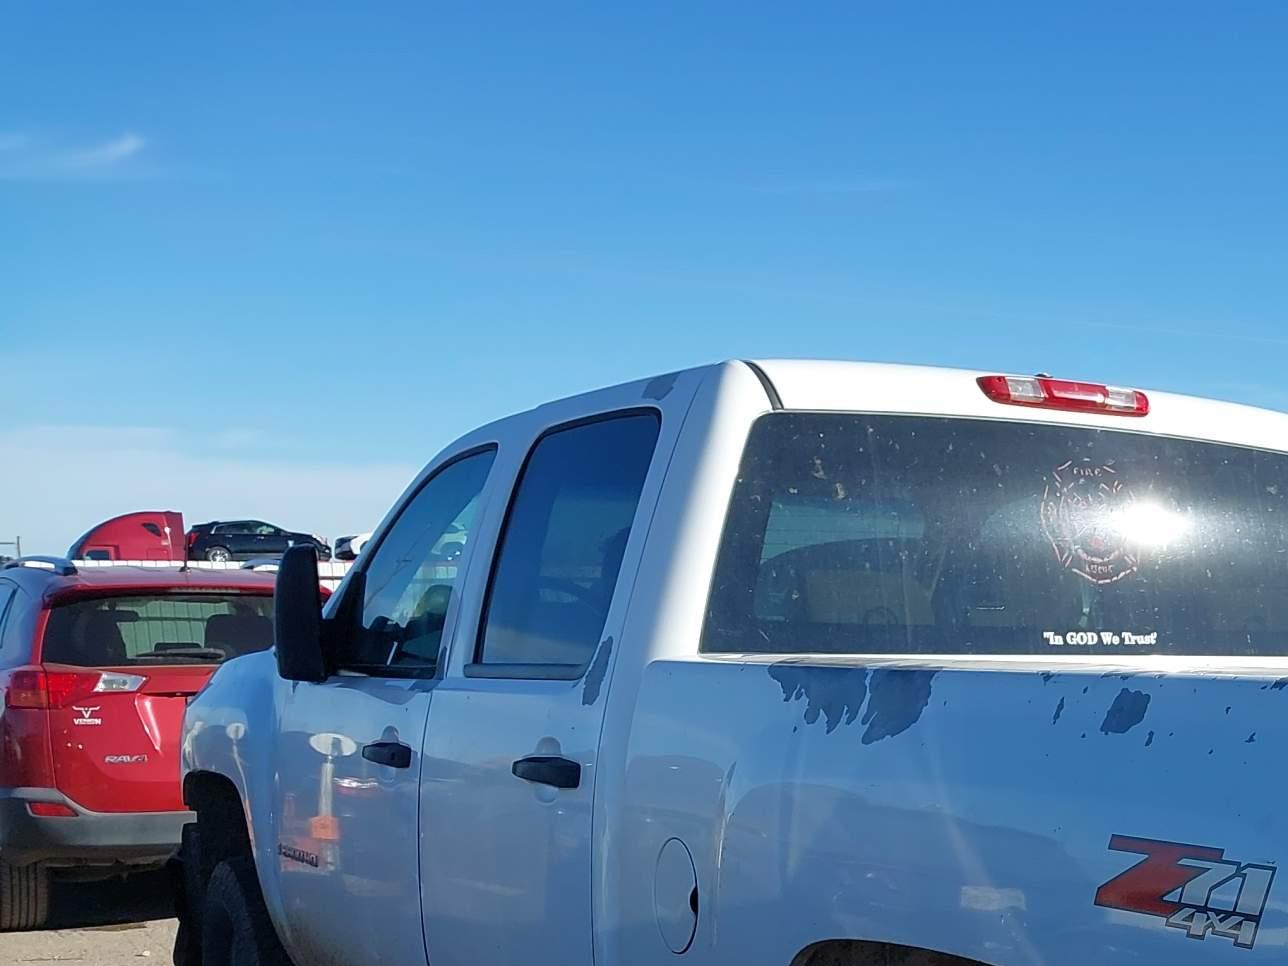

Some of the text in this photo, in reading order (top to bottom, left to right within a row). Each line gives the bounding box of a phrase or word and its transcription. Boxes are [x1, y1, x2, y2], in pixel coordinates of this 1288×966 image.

[1066, 632, 1098, 645] GOD
[1100, 632, 1120, 645] We
[1094, 834, 1277, 917] Z71
